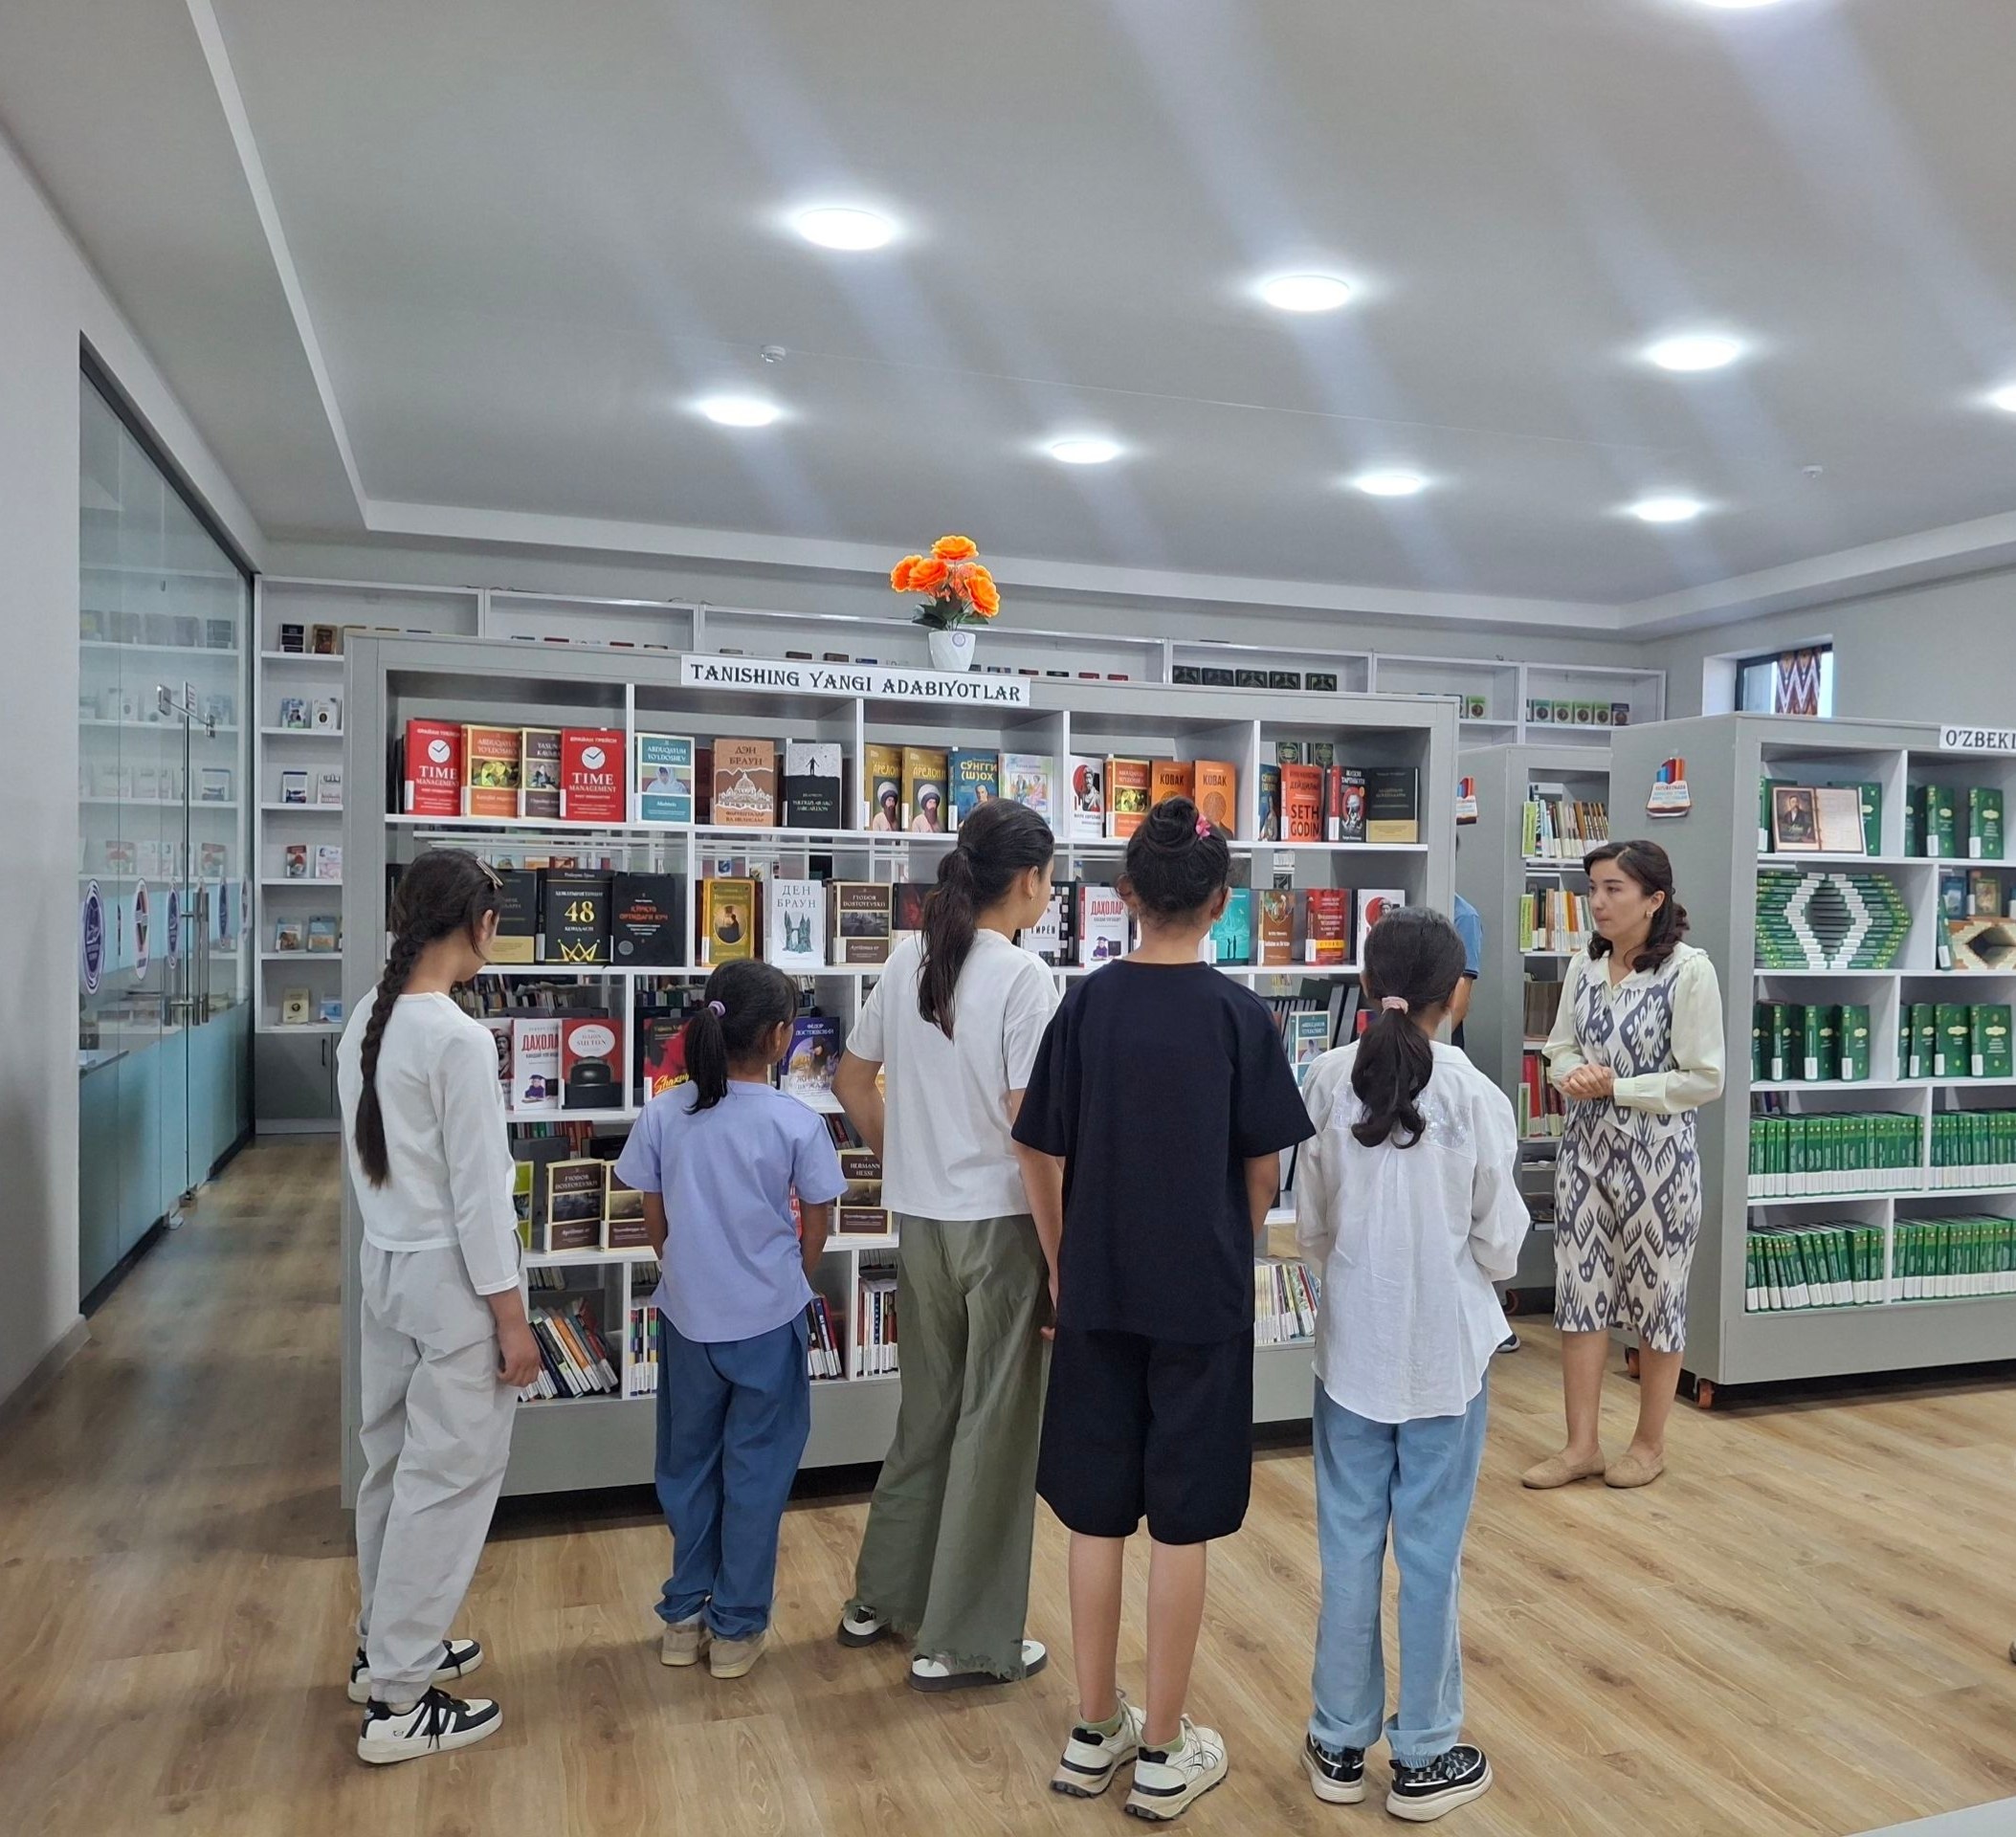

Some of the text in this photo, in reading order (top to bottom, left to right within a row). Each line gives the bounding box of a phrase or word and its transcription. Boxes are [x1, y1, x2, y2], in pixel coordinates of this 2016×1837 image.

[691, 664, 1021, 702] TANISHING YANGI ADABIYOTLAR
[735, 745, 757, 755] ДЭН
[729, 756, 763, 765] БРАУН
[960, 760, 998, 772] СЎНГГИ
[418, 765, 457, 781] TIME
[571, 772, 614, 786] TIME
[568, 785, 616, 793] MANAGEMENT
[1291, 804, 1319, 820] SETH
[1290, 820, 1320, 837] GODIN
[782, 885, 810, 896] ДЕН
[777, 898, 816, 908] БРАУН
[564, 900, 595, 923] 48
